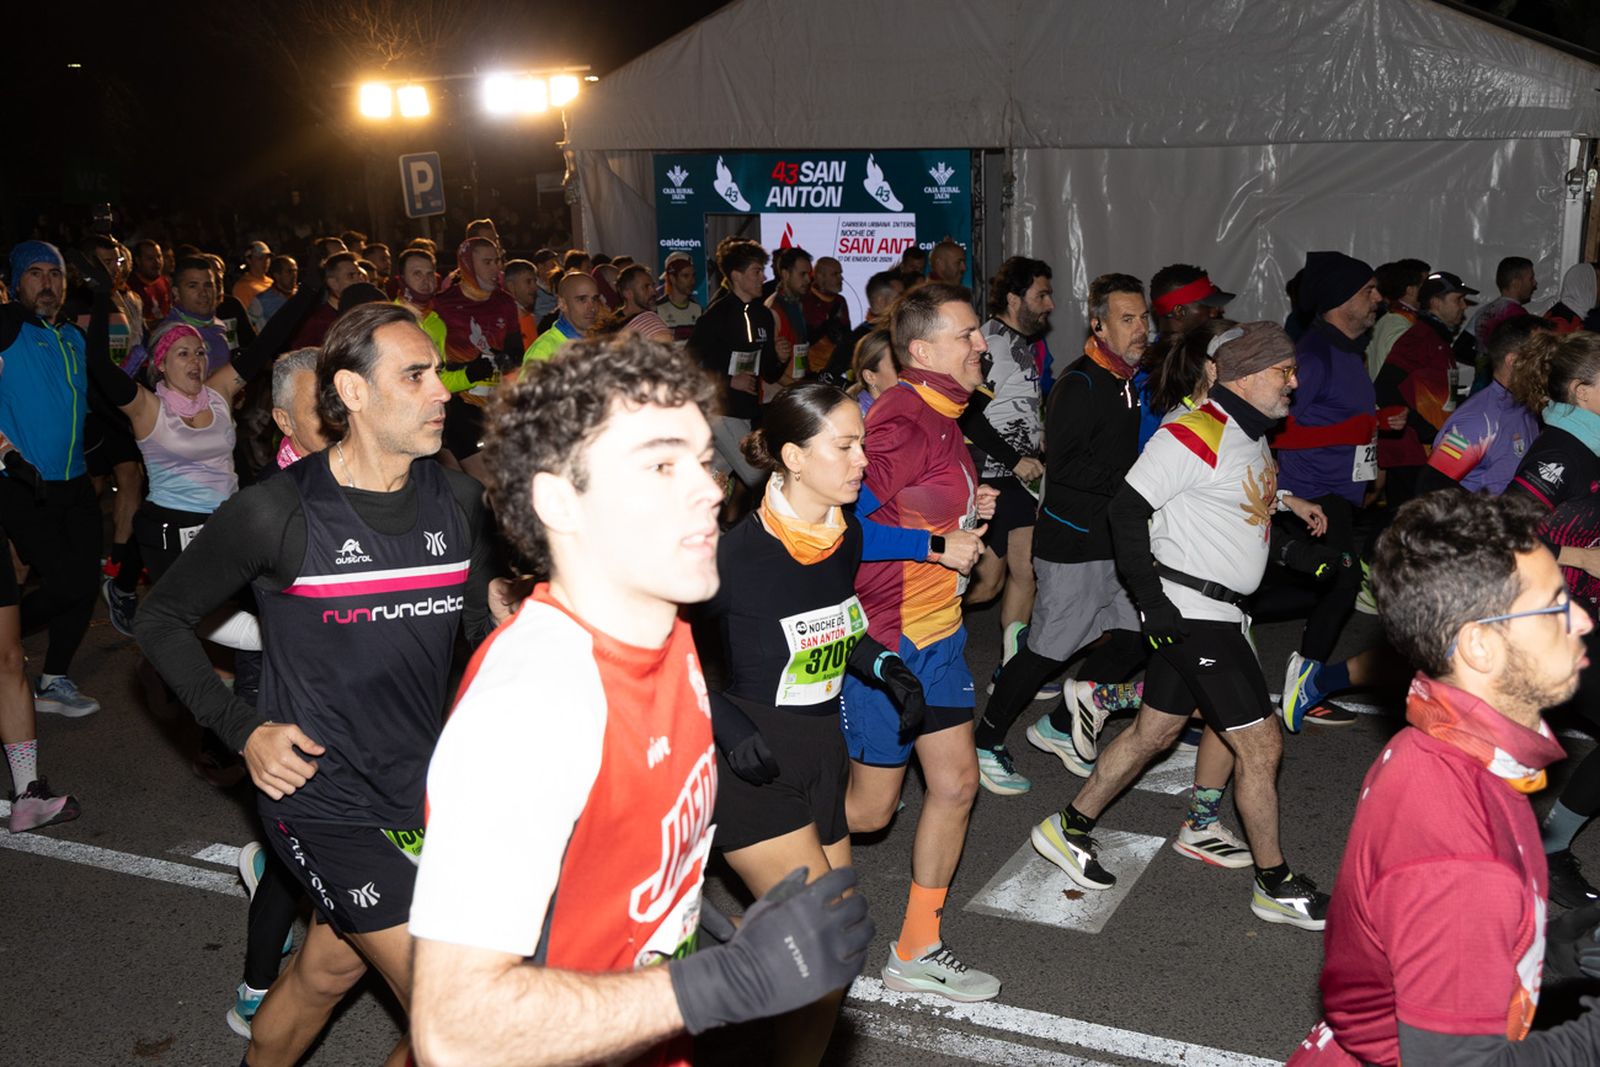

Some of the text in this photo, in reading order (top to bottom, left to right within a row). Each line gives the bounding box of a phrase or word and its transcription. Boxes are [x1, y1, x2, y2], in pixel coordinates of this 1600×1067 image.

[771, 161, 846, 185] 43 SAN
[409, 160, 434, 209] P
[724, 187, 738, 203] 43
[765, 180, 843, 208] ANTÓN
[875, 186, 890, 203] 43
[840, 229, 876, 237] NOCHE DE
[659, 238, 702, 248] calderón
[838, 237, 875, 254] SAN
[809, 618, 836, 634] NOCHE
[836, 614, 845, 626] DE
[800, 635, 818, 650] SAN
[805, 635, 857, 675] 3708
